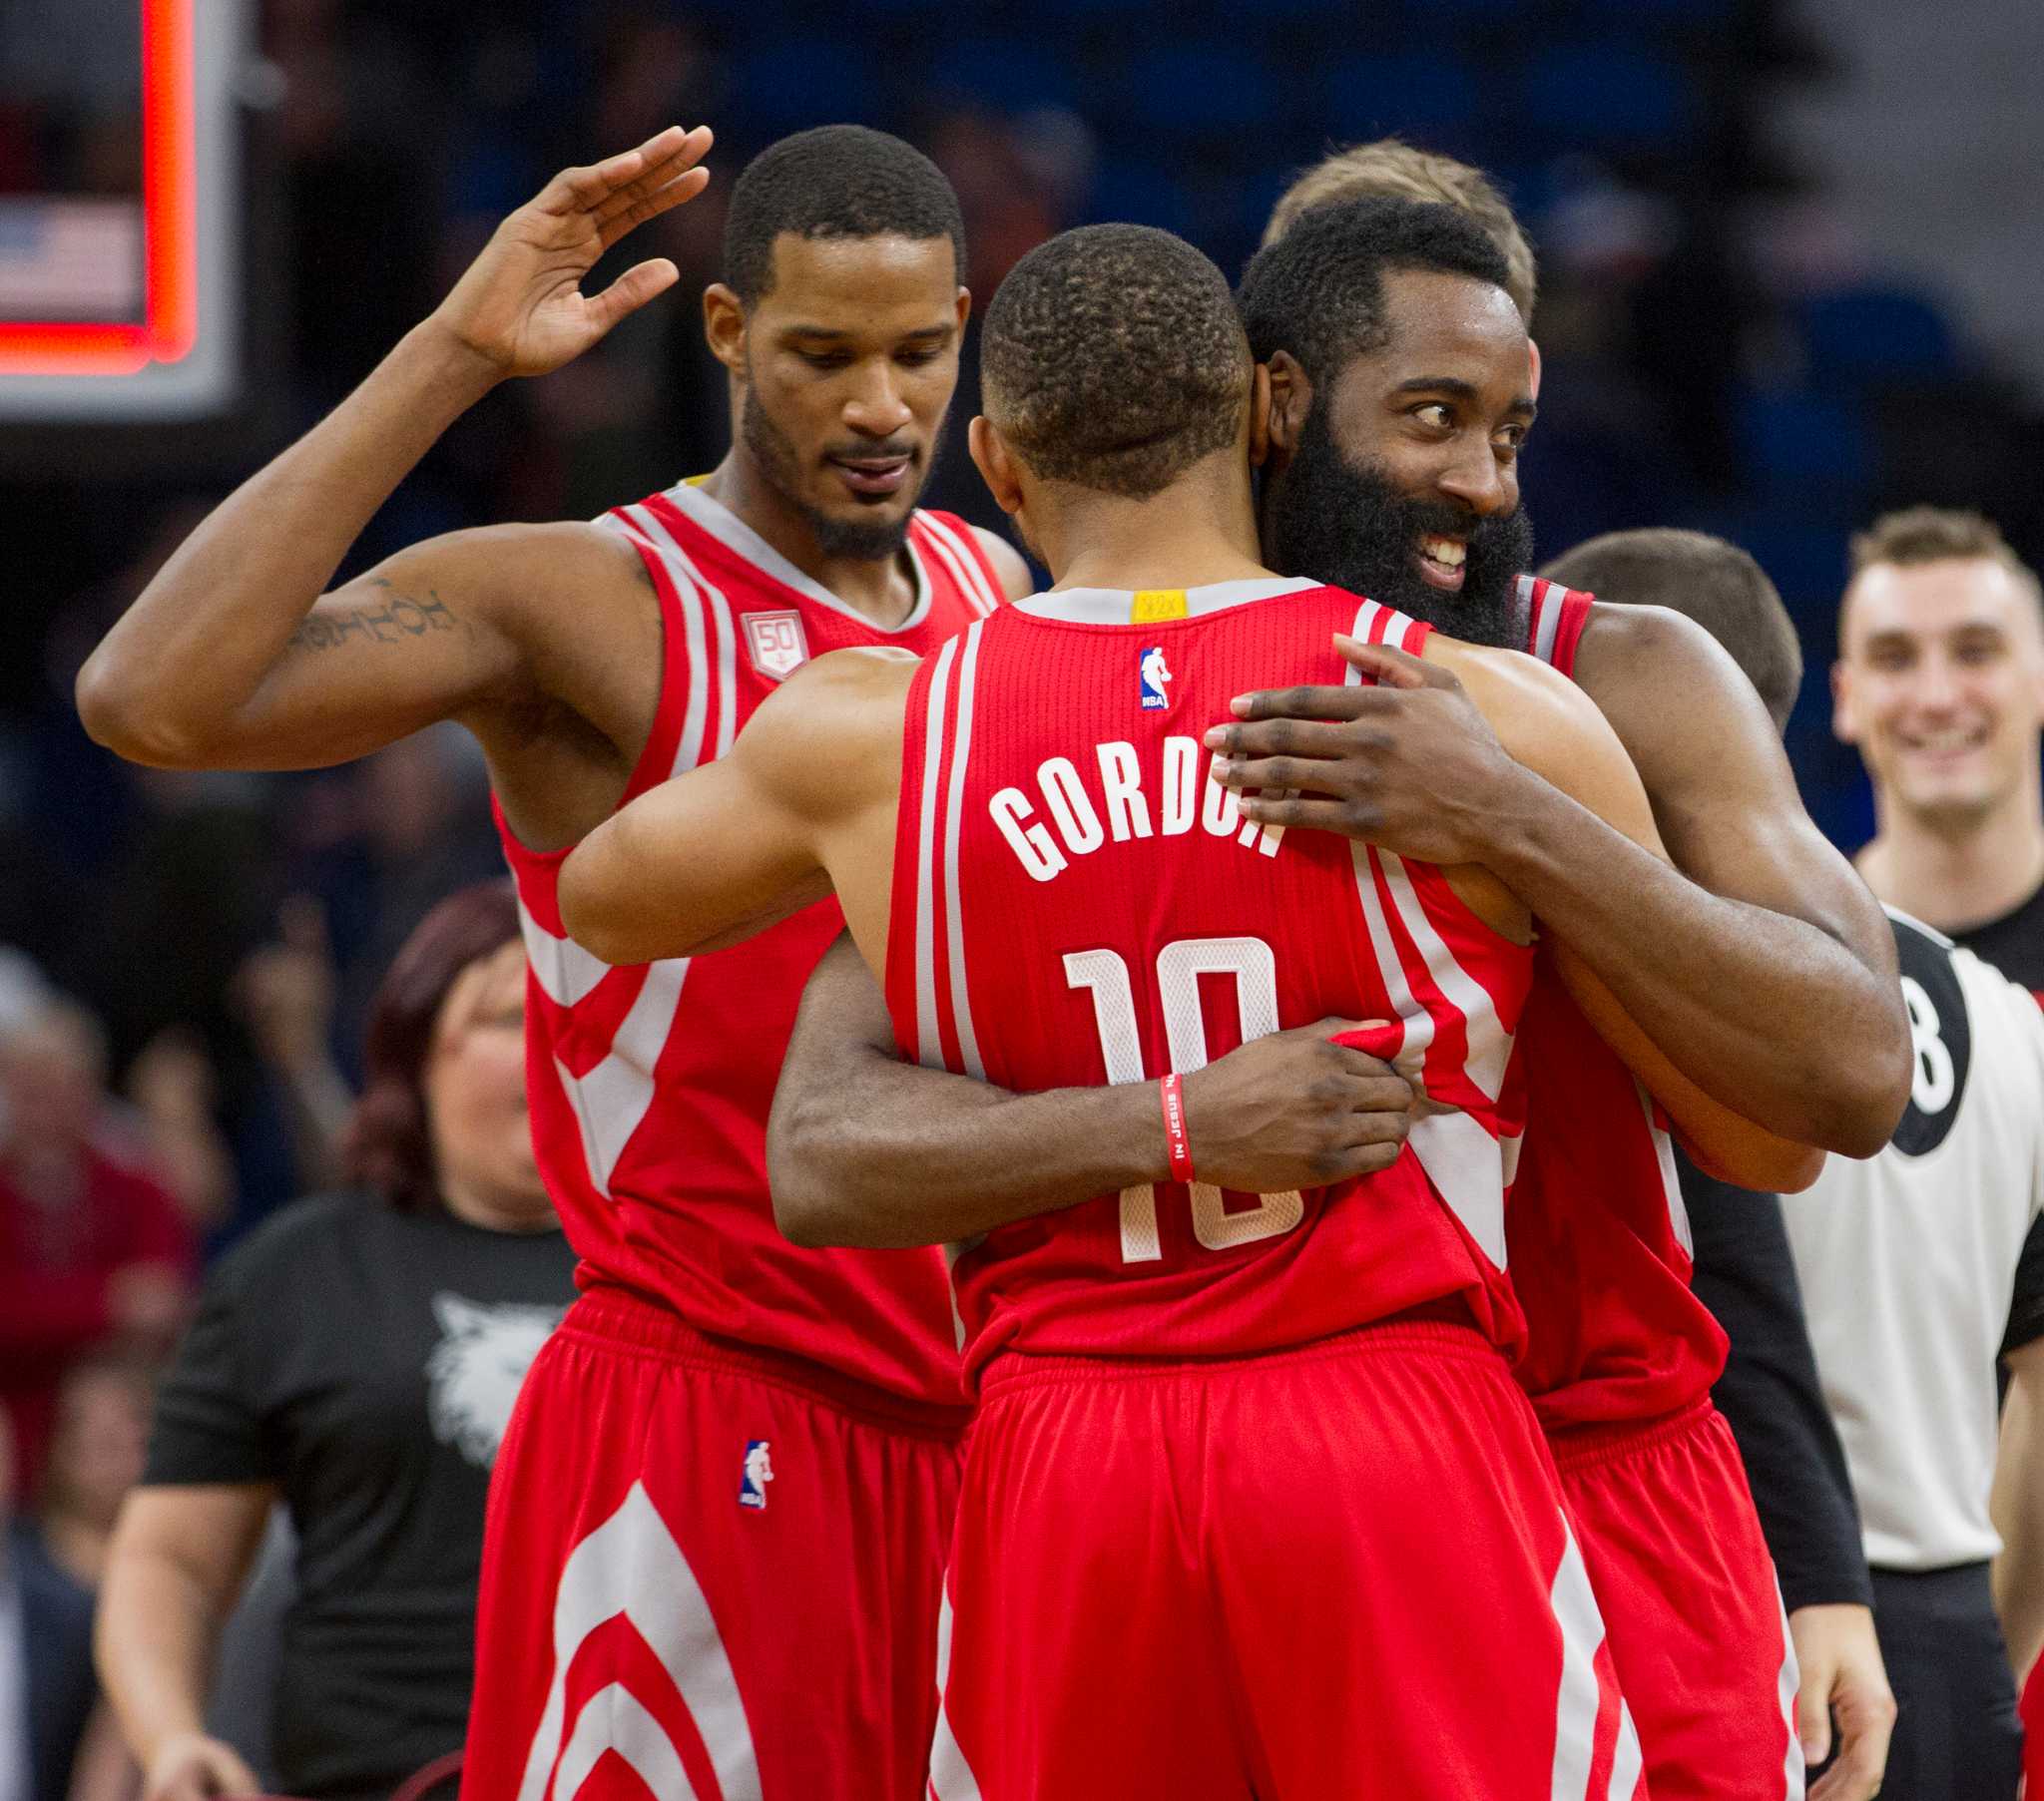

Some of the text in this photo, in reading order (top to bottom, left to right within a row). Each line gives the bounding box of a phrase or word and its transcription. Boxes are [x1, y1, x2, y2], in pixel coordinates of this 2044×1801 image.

[757, 622, 794, 652] 50
[1142, 695, 1164, 707] NBA
[1062, 937, 1304, 1263] 10
[1168, 1094, 1182, 1138] JESUS
[1175, 1143, 1185, 1159] IN
